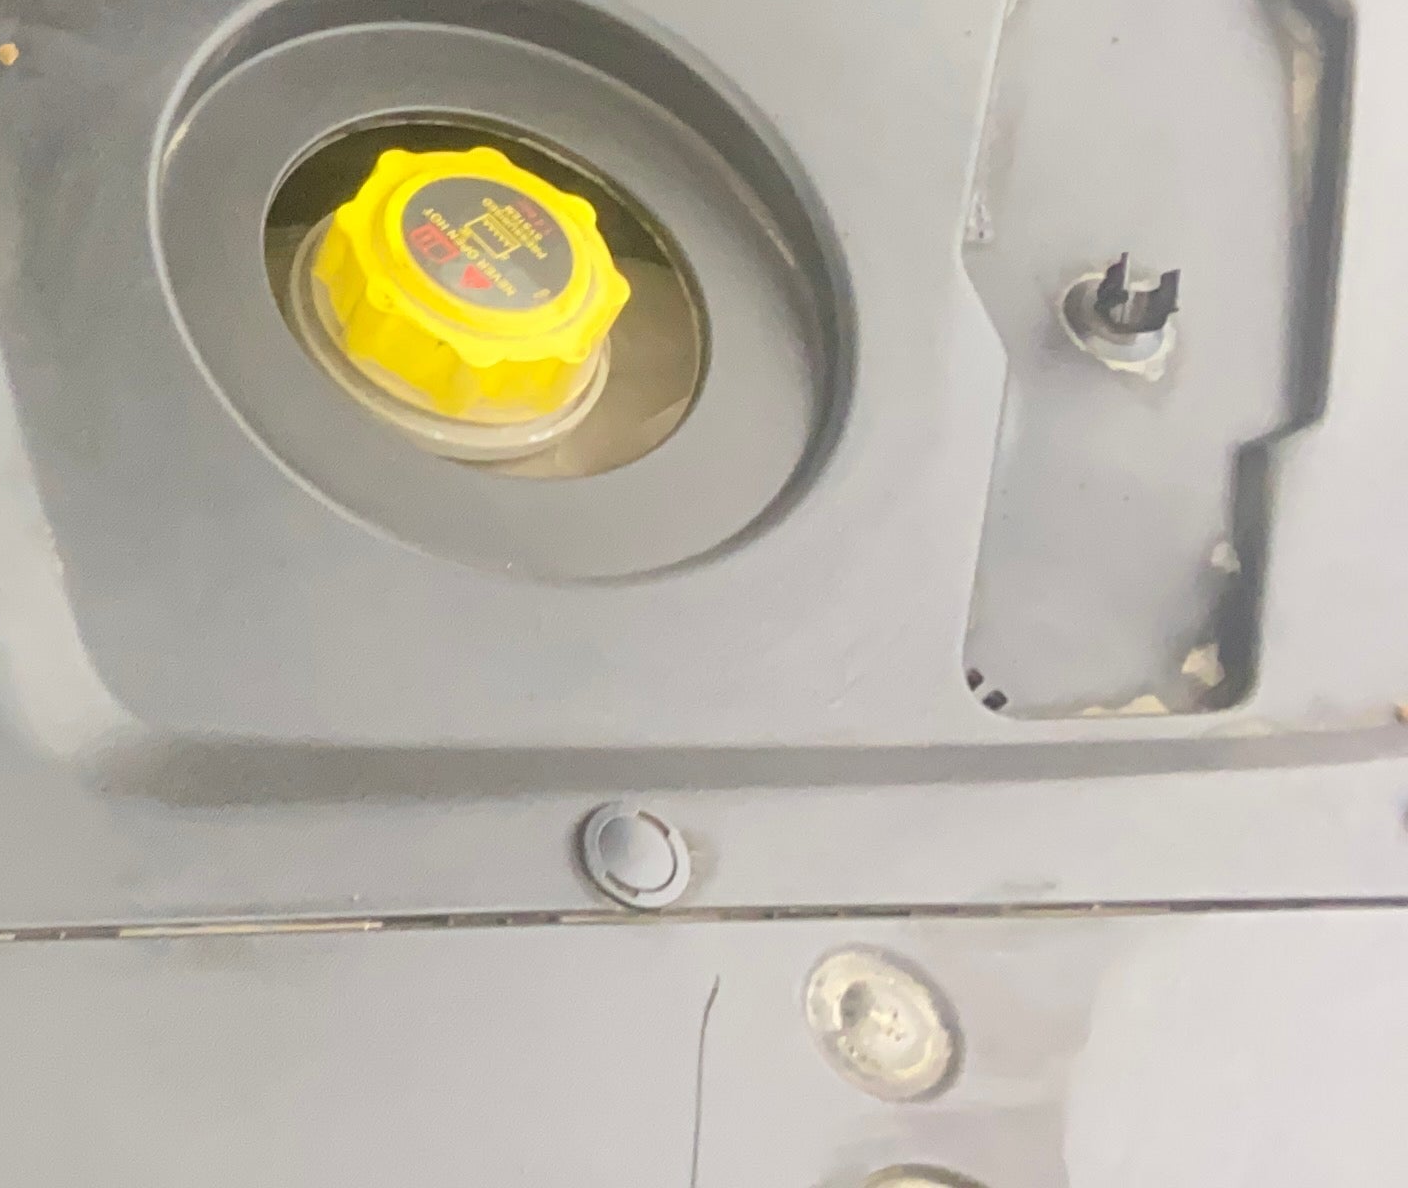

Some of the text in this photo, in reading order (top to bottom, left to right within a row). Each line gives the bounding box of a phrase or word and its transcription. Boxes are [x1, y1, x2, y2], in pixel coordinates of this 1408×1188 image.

[422, 208, 516, 296] NEVER OPEN HOT
